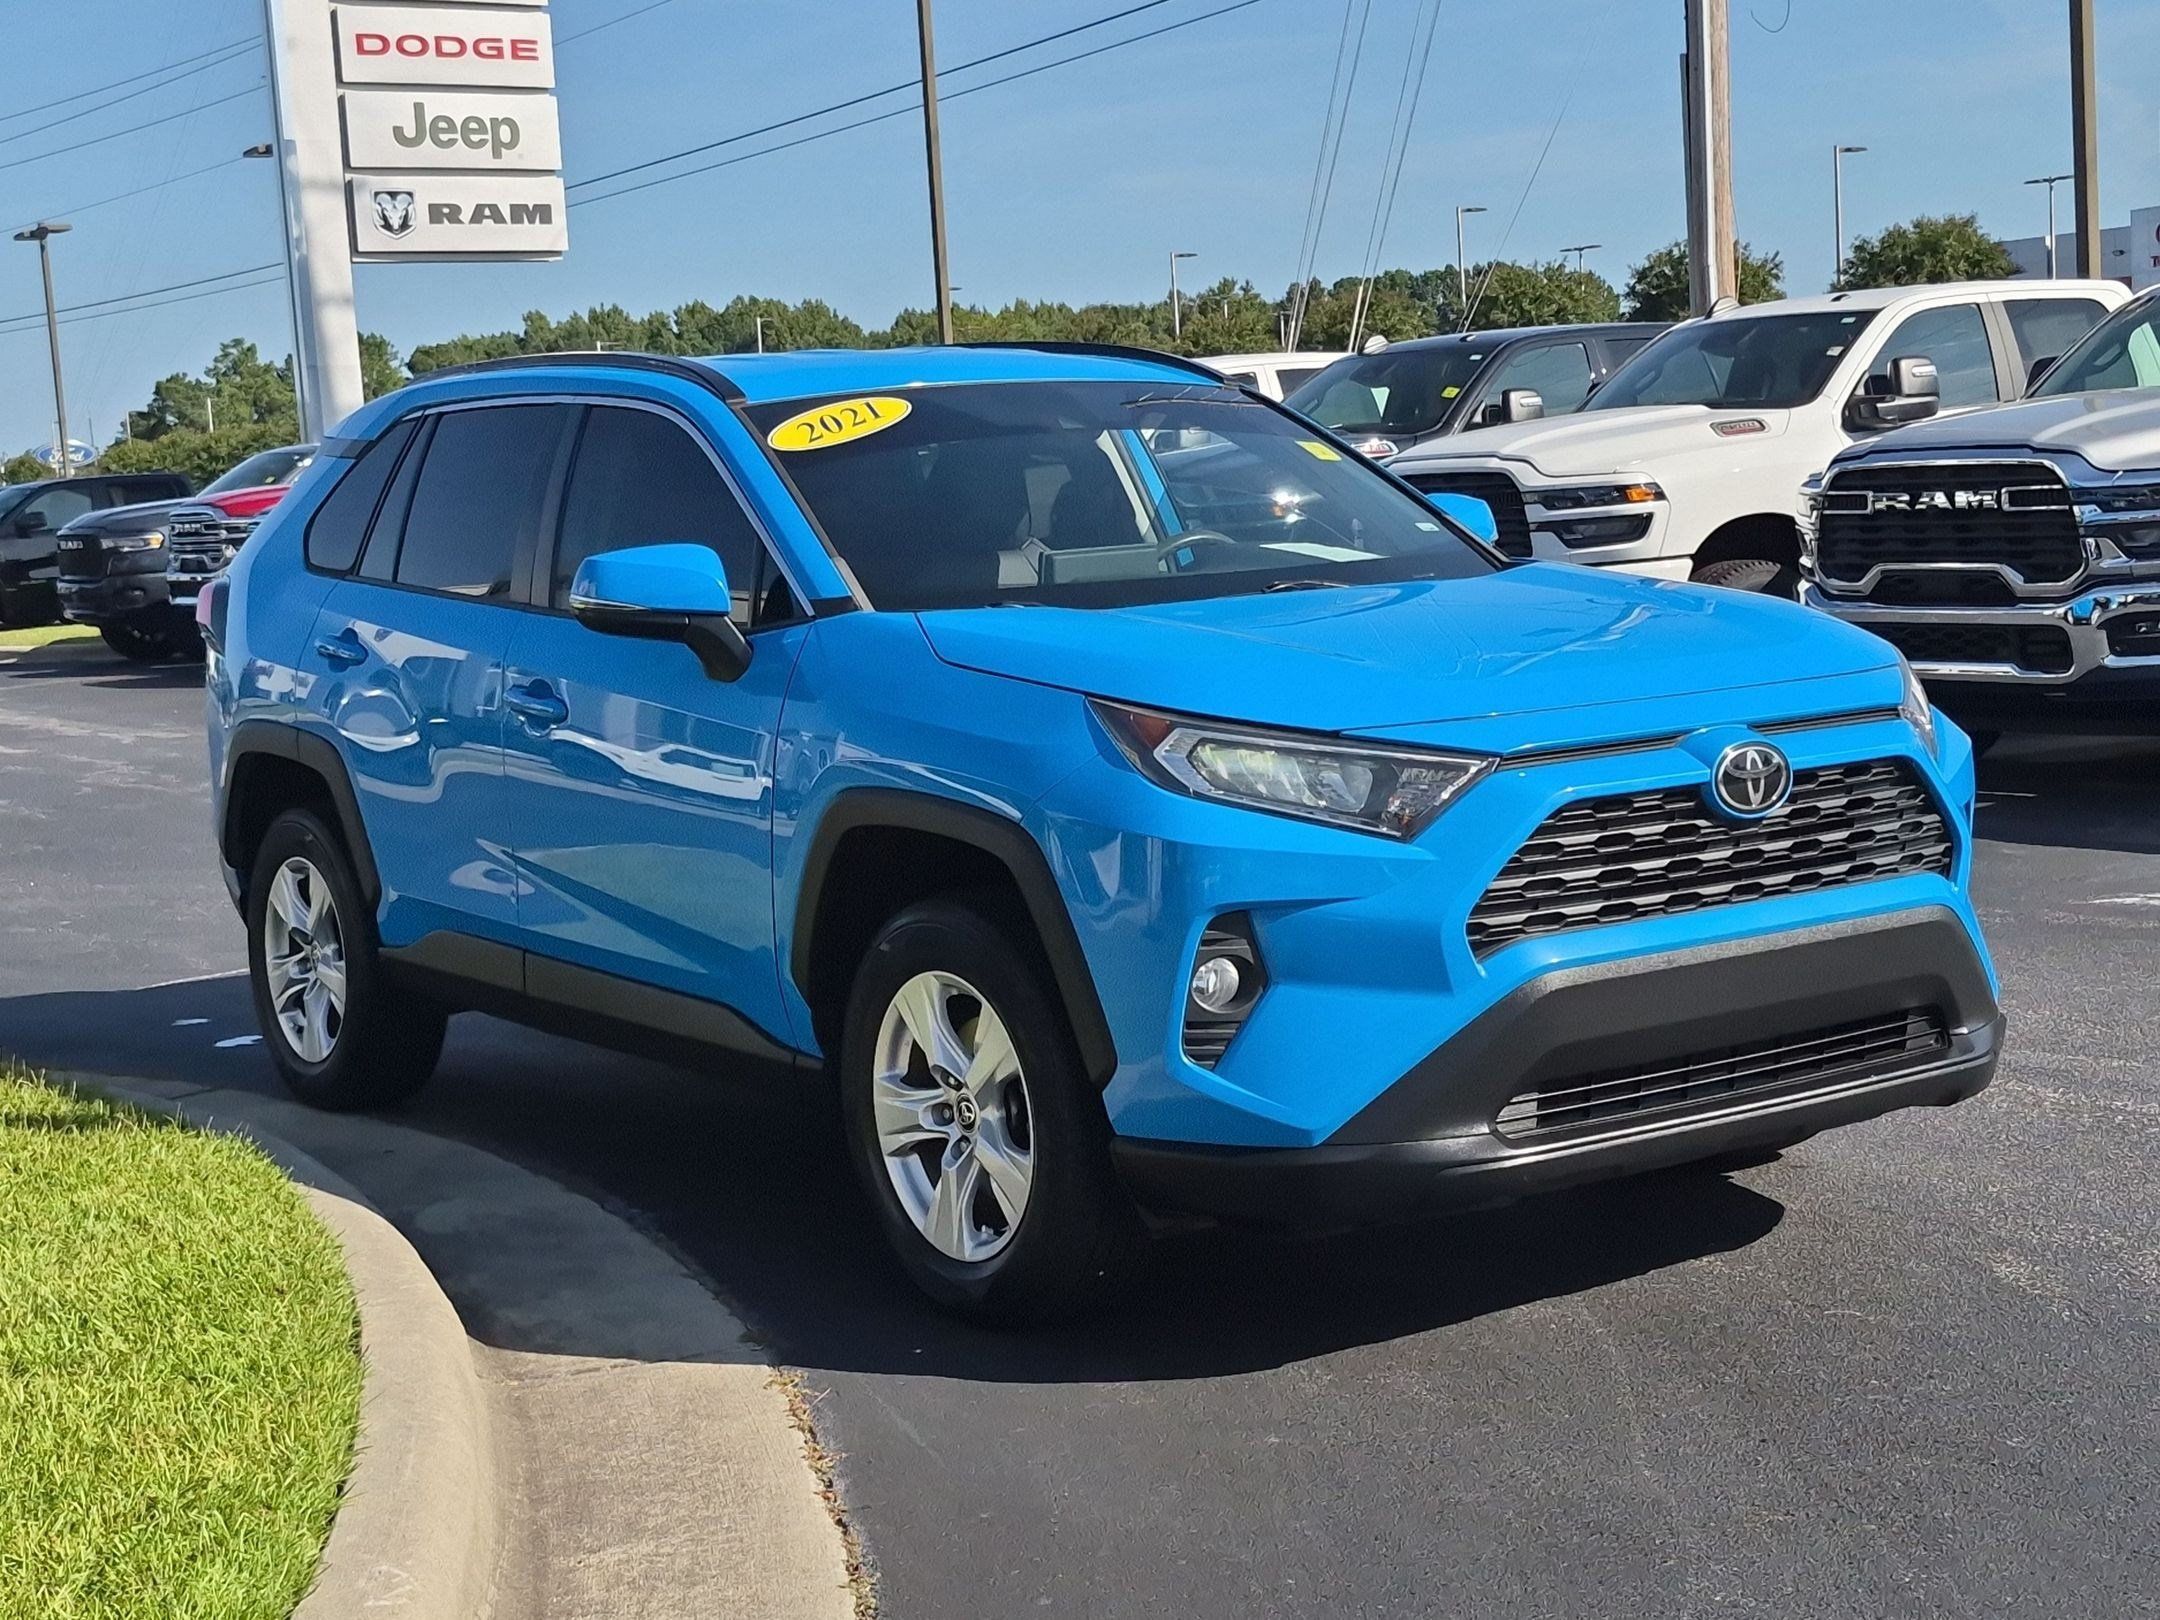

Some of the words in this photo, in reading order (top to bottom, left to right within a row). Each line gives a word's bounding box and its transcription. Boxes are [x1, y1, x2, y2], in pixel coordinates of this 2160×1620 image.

[355, 33, 539, 61] DODGE
[392, 102, 520, 159] Jeep
[427, 203, 553, 225] RAM
[796, 401, 884, 443] 2021
[49, 447, 85, 462] Frd
[1872, 490, 1998, 510] RAM
